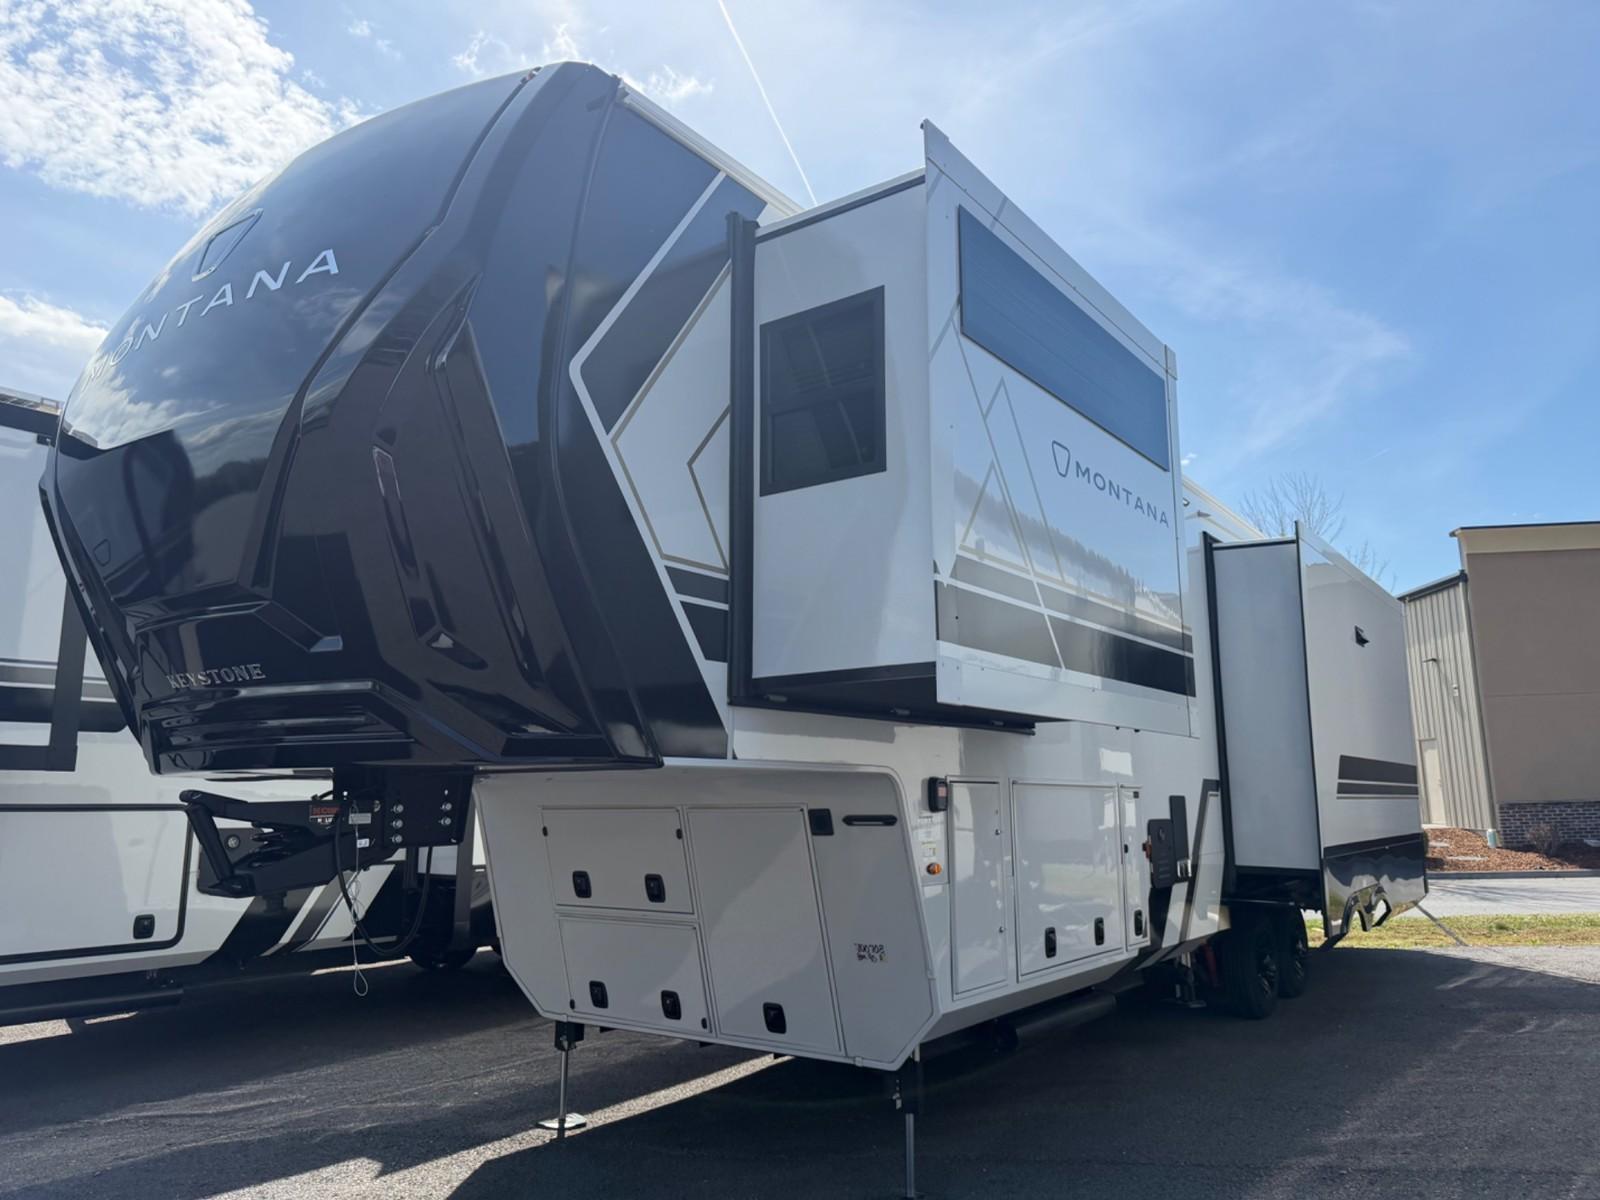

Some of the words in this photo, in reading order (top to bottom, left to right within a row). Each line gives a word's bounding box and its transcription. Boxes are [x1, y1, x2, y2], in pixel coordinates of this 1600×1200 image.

[80, 248, 339, 392] MONTANA
[1075, 460, 1169, 528] MONTANA
[166, 663, 266, 689] KEYSTONE
